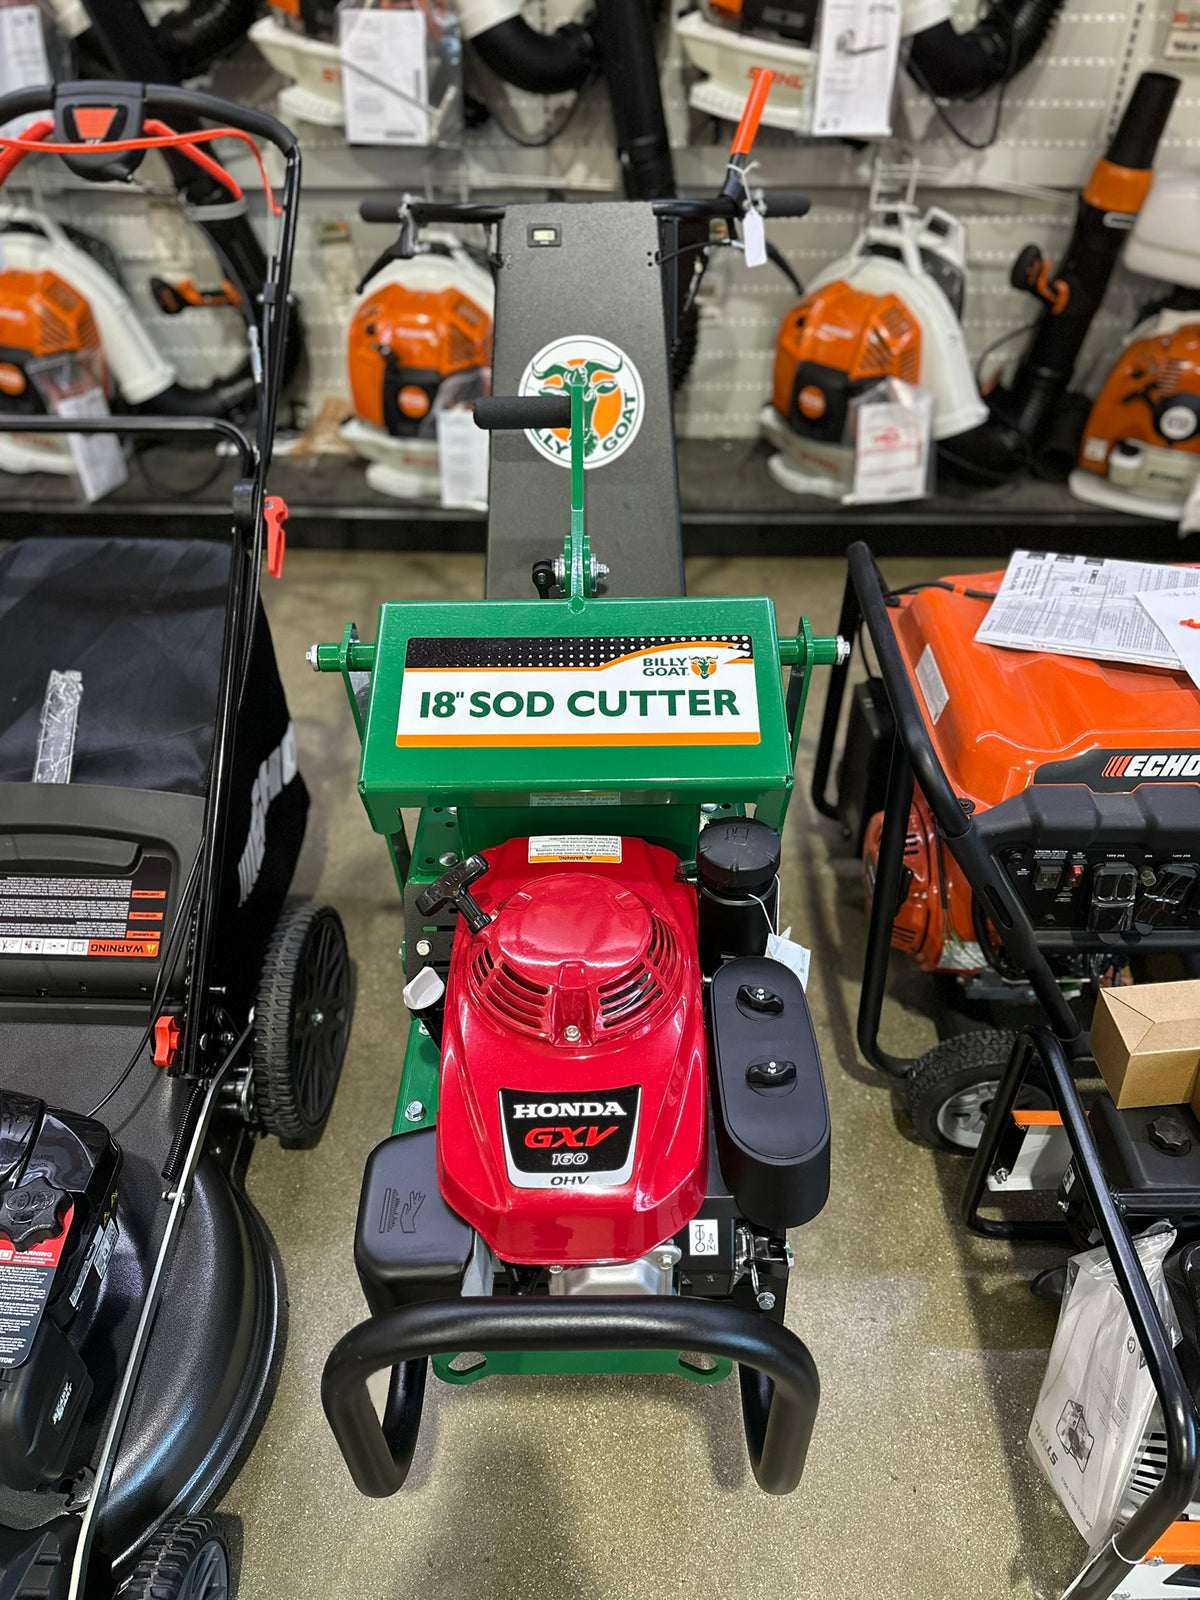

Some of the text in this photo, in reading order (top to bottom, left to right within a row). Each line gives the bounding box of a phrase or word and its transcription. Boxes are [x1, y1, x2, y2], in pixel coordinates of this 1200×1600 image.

[602, 392, 636, 452] GOAT
[643, 658, 688, 666] BILLY
[642, 667, 688, 676] GOAT
[419, 689, 741, 718] 18" SOD CUTTER
[90, 943, 144, 953] WARNING
[512, 1101, 627, 1119] HONDA
[524, 1125, 620, 1148] GXV
[551, 1152, 588, 1166] 160
[550, 1174, 590, 1187] OHV
